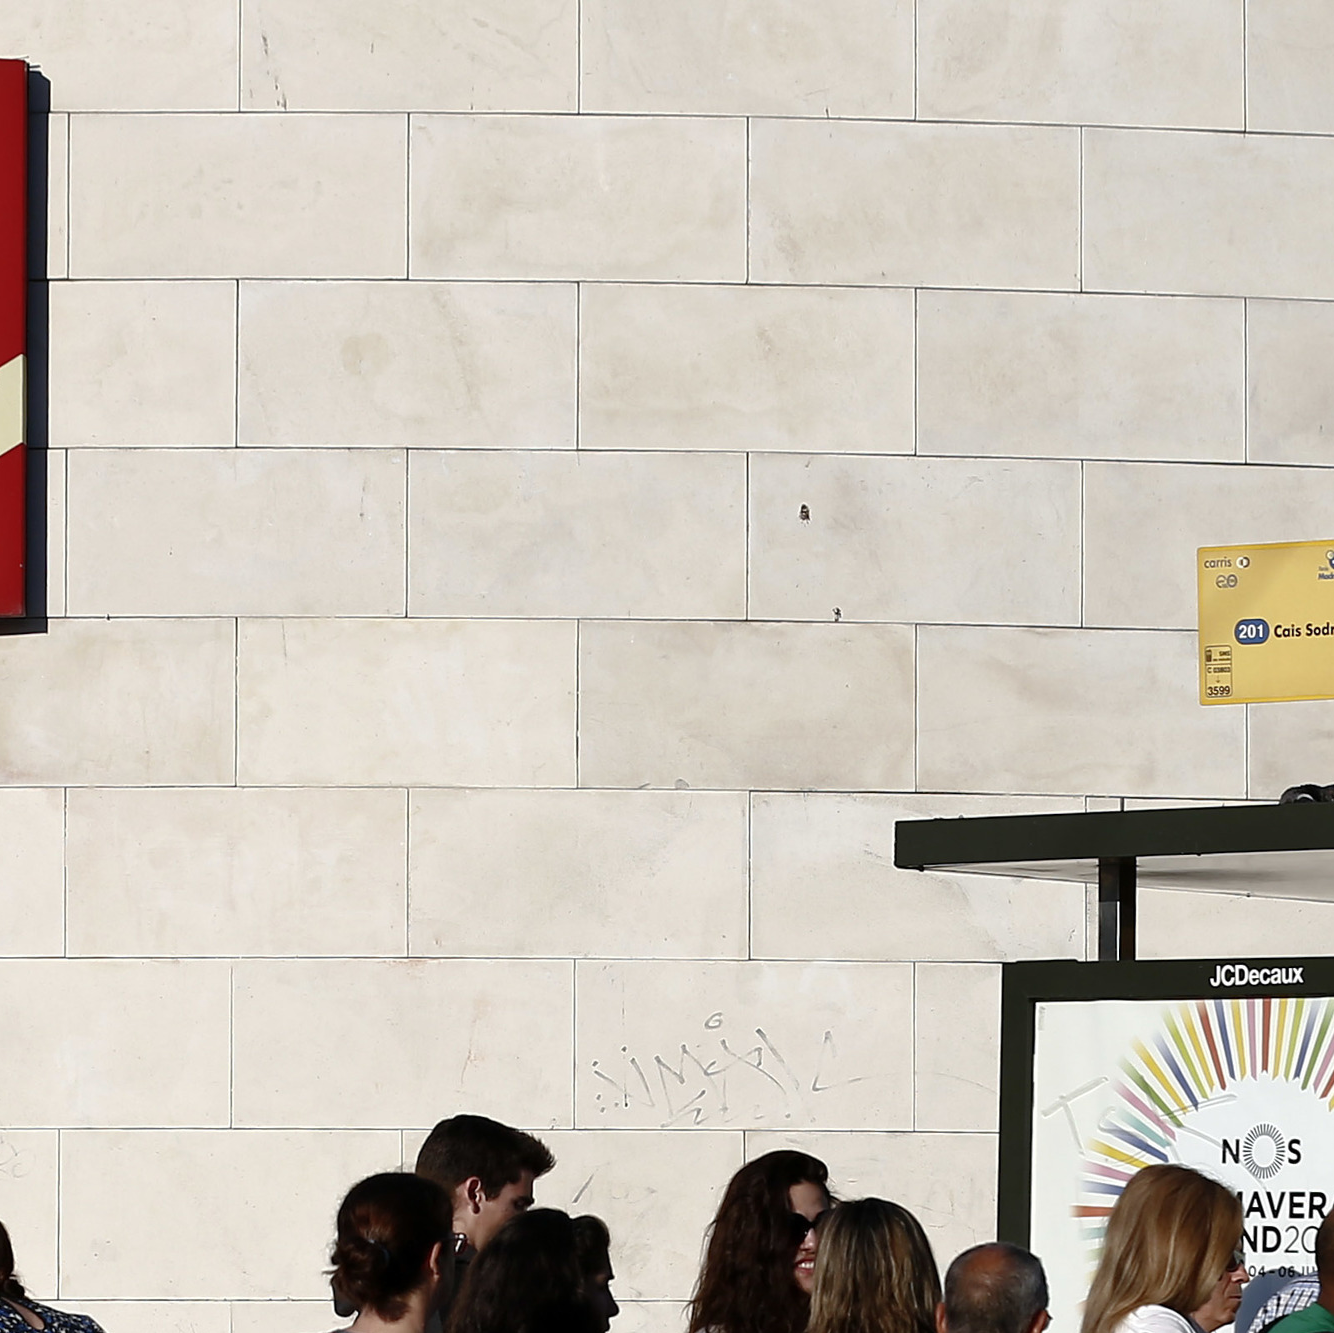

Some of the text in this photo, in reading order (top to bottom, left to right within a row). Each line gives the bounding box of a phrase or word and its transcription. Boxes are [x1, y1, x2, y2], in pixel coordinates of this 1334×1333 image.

[1204, 557, 1232, 568] carris
[1238, 624, 1264, 639] 201
[1274, 624, 1301, 637] Cais
[1207, 685, 1231, 696] 3599
[1209, 964, 1305, 987] JCDecaux
[1221, 1123, 1302, 1180] NOS
